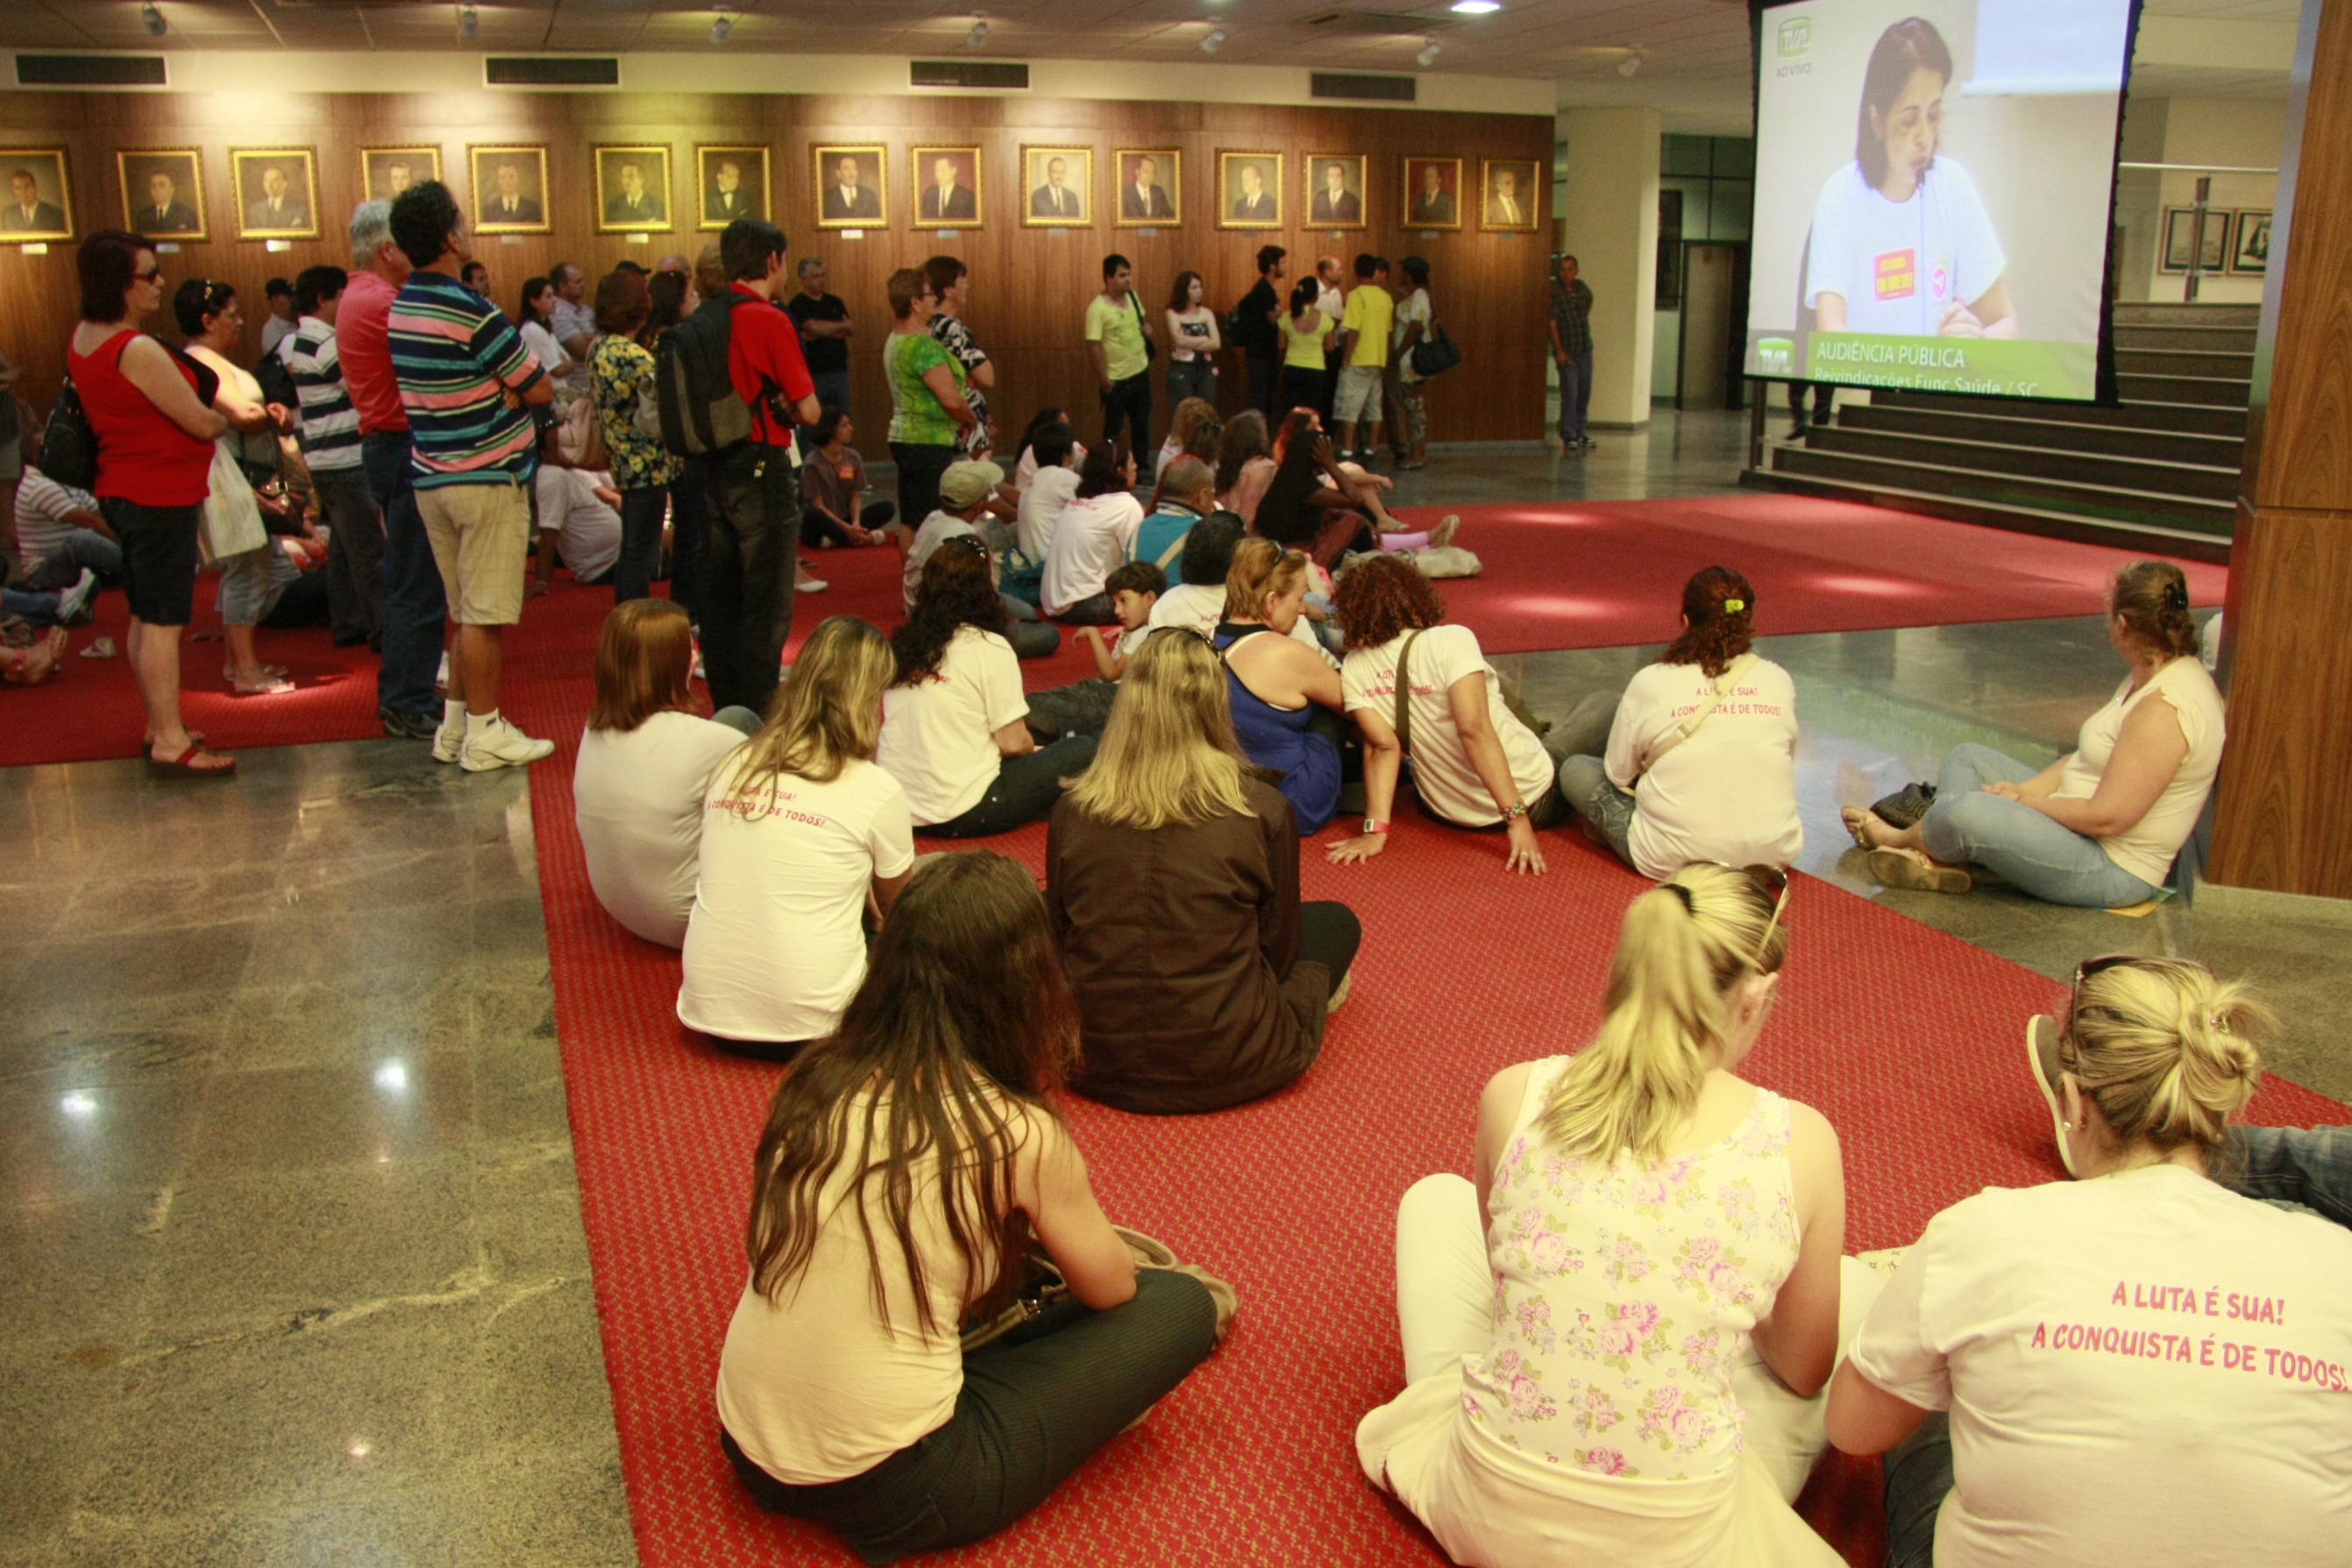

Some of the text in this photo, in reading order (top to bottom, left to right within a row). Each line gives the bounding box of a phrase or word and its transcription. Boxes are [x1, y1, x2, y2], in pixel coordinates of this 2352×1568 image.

[1775, 62, 1811, 78] AO VIVO
[1817, 340, 1965, 369] AUDIÊNCIA PÚBLICA
[1695, 687, 1702, 696] A
[1737, 686, 1759, 696] SUA!
[1671, 708, 1676, 718] A
[1730, 702, 1736, 714] É
[1738, 704, 1751, 714] DE
[769, 805, 783, 817] DE
[785, 809, 827, 827] TODOS!
[2111, 1280, 2285, 1326] A LUTA É SUA!
[2031, 1321, 2349, 1392] A CONQUISTA É DE TODOS!
